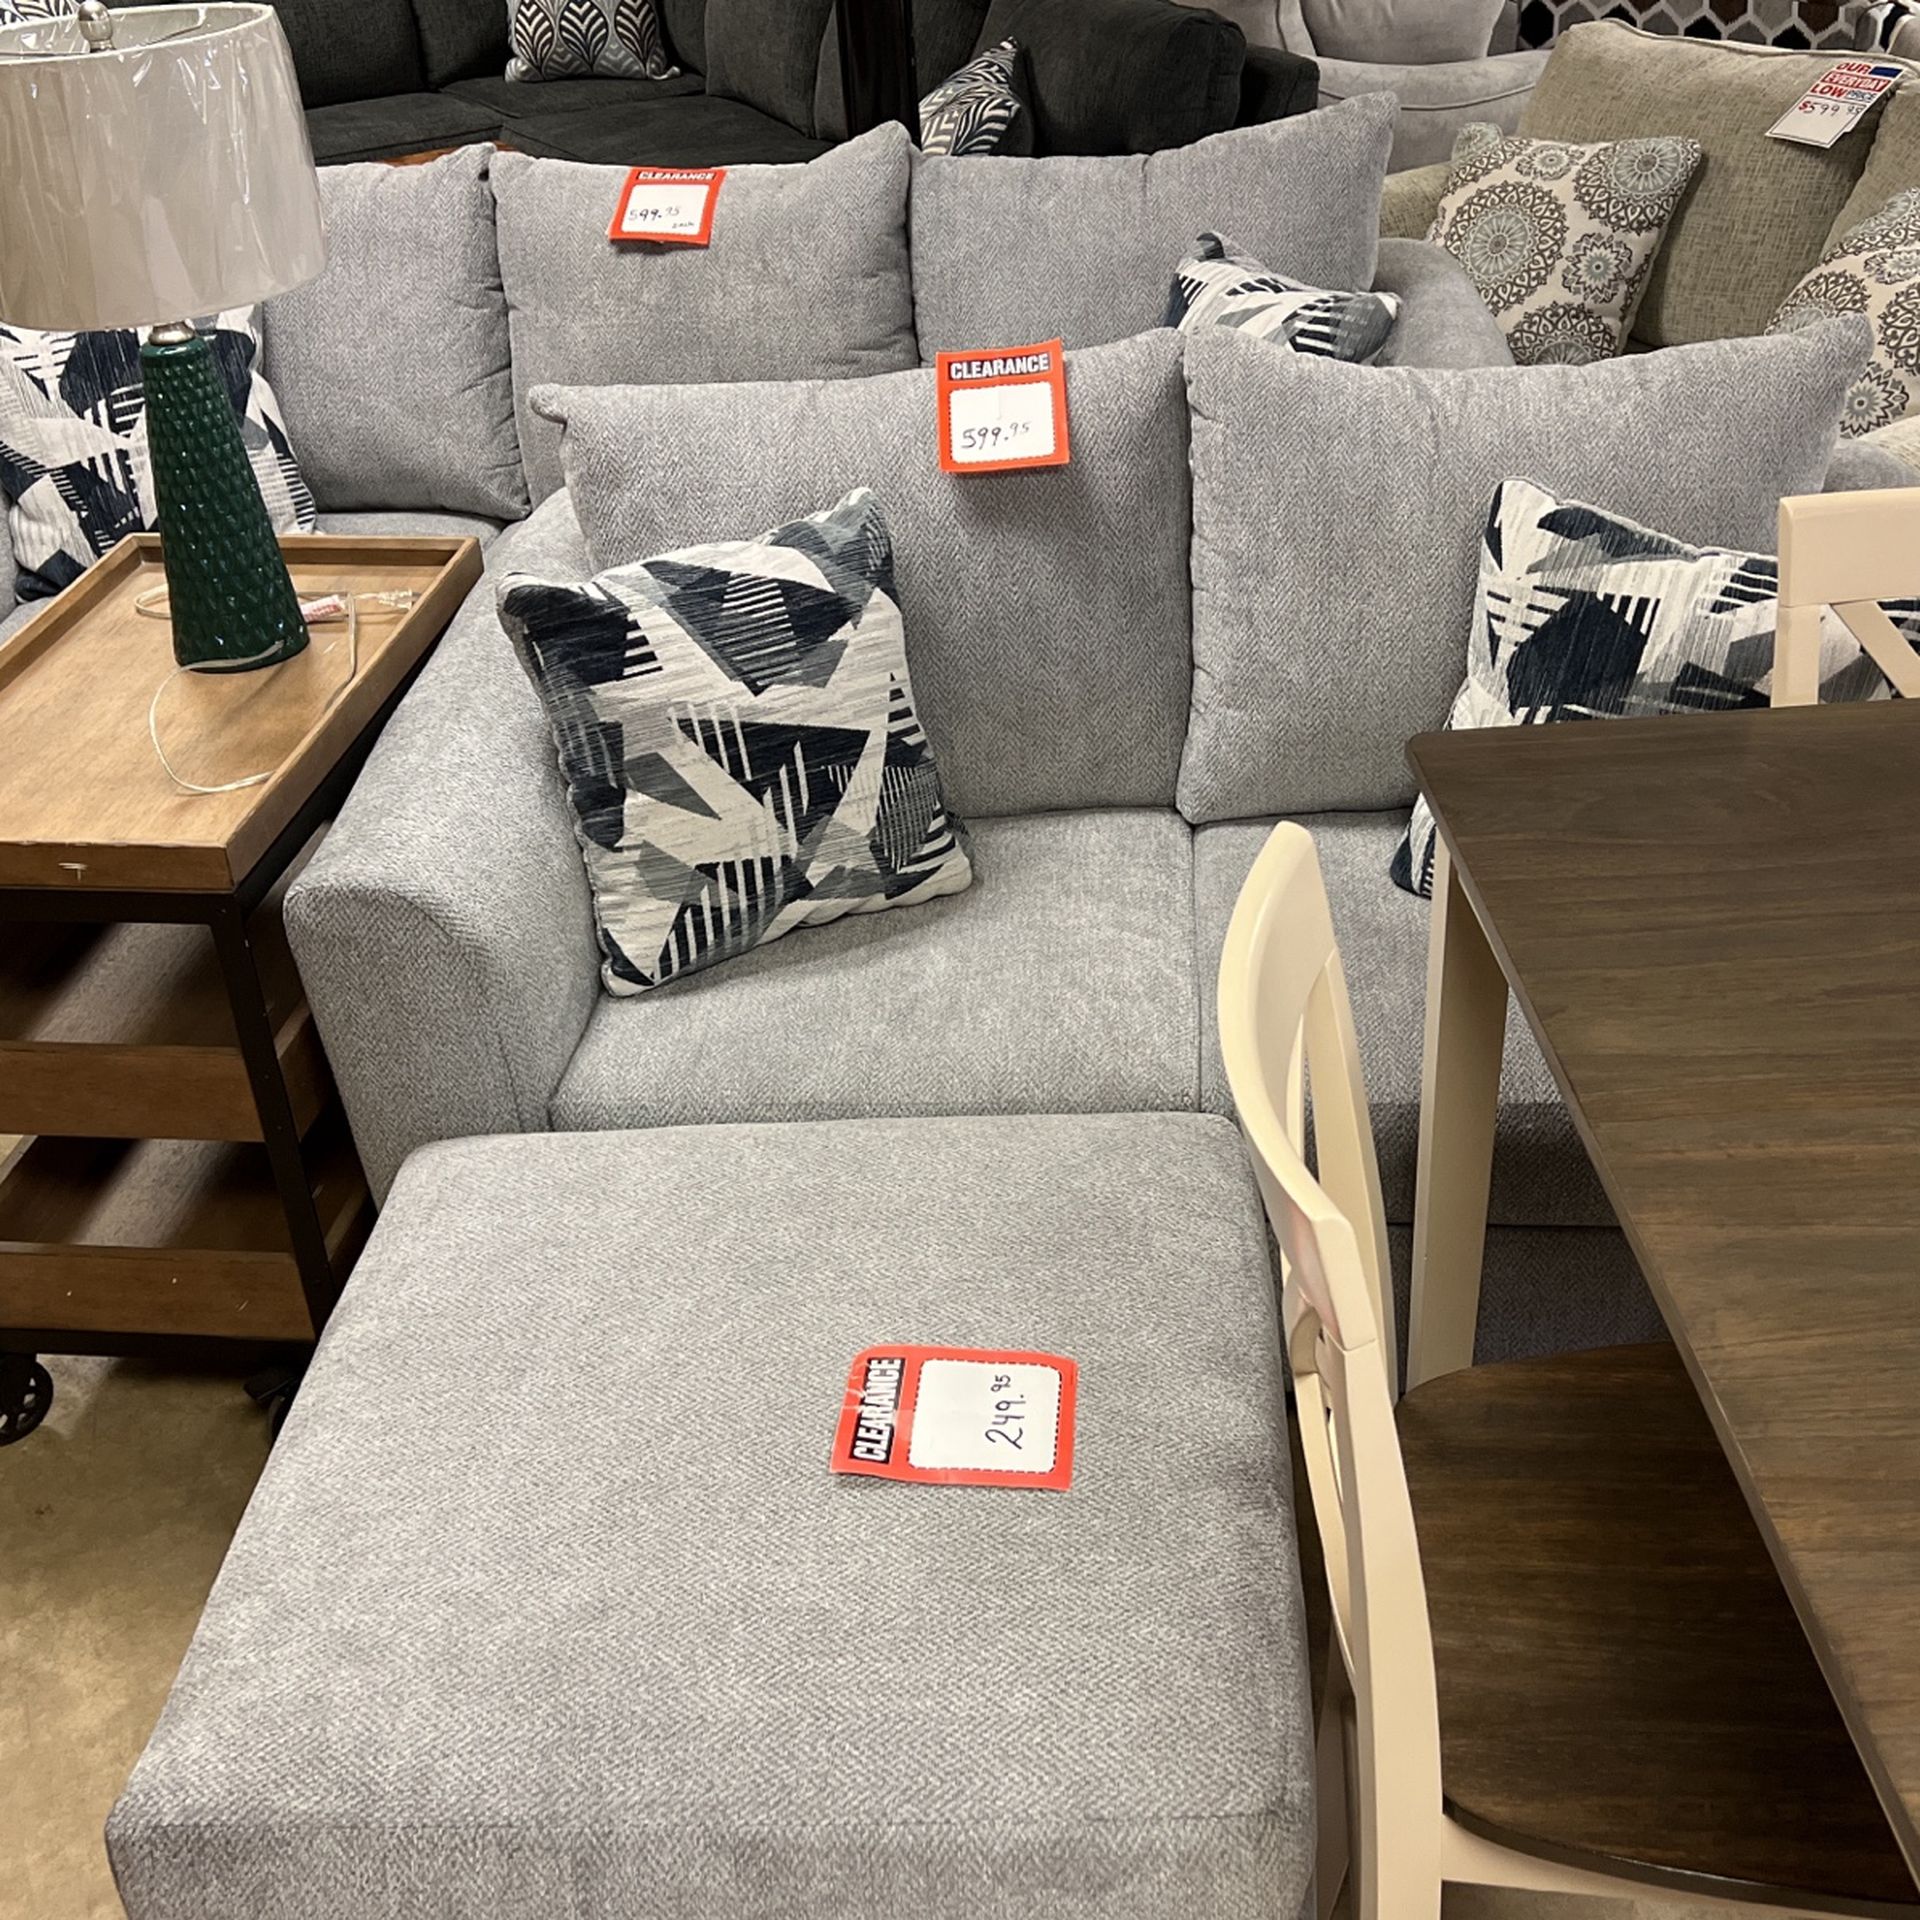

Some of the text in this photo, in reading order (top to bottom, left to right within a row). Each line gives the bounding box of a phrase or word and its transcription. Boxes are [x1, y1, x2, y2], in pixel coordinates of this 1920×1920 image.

[1835, 62, 1872, 75] OUR
[1810, 83, 1847, 98] LOW
[638, 170, 715, 181] CLEARANCE
[949, 352, 1050, 380] CLEARANCE
[852, 1357, 903, 1462] CLEARANCE
